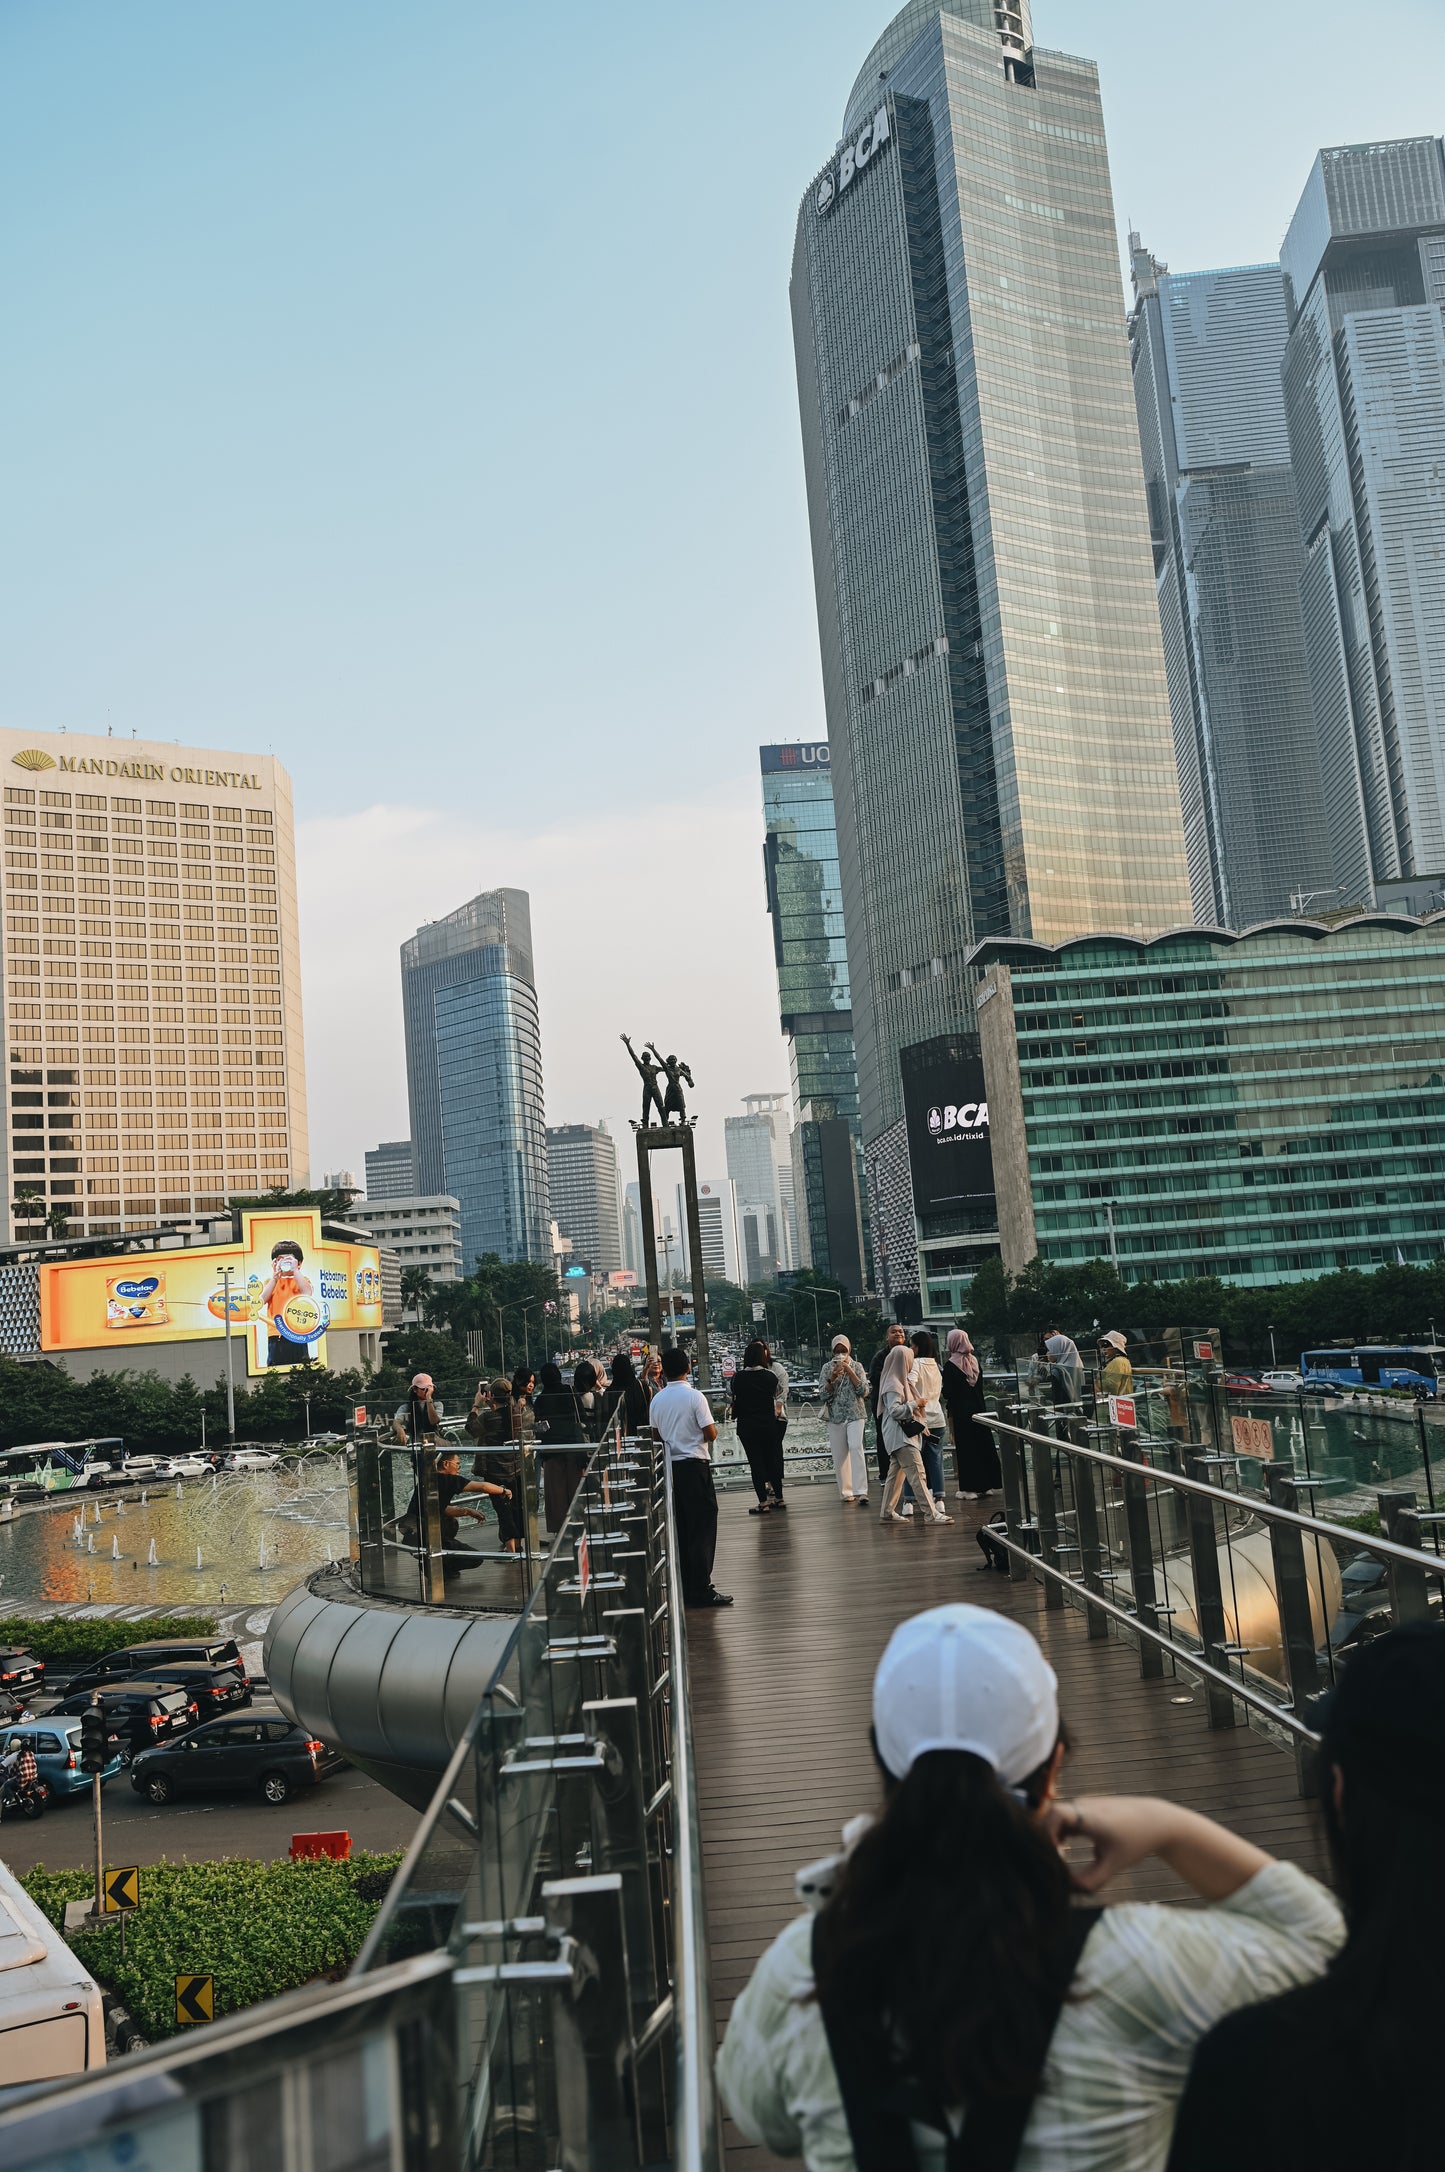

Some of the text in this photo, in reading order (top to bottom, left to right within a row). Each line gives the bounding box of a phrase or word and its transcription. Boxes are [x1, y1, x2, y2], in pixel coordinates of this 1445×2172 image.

[839, 105, 890, 192] BCA
[59, 755, 262, 789] MANDARIN ORIENTAL
[944, 1103, 990, 1130] BCA
[937, 1132, 984, 1144] bca.co.id/tixid
[320, 1269, 347, 1283] Hebatnya
[120, 1285, 154, 1293] Bebelac
[321, 1283, 348, 1299] Bebelac
[276, 1316, 306, 1341] Internationally
[308, 1328, 324, 1340] Tested
